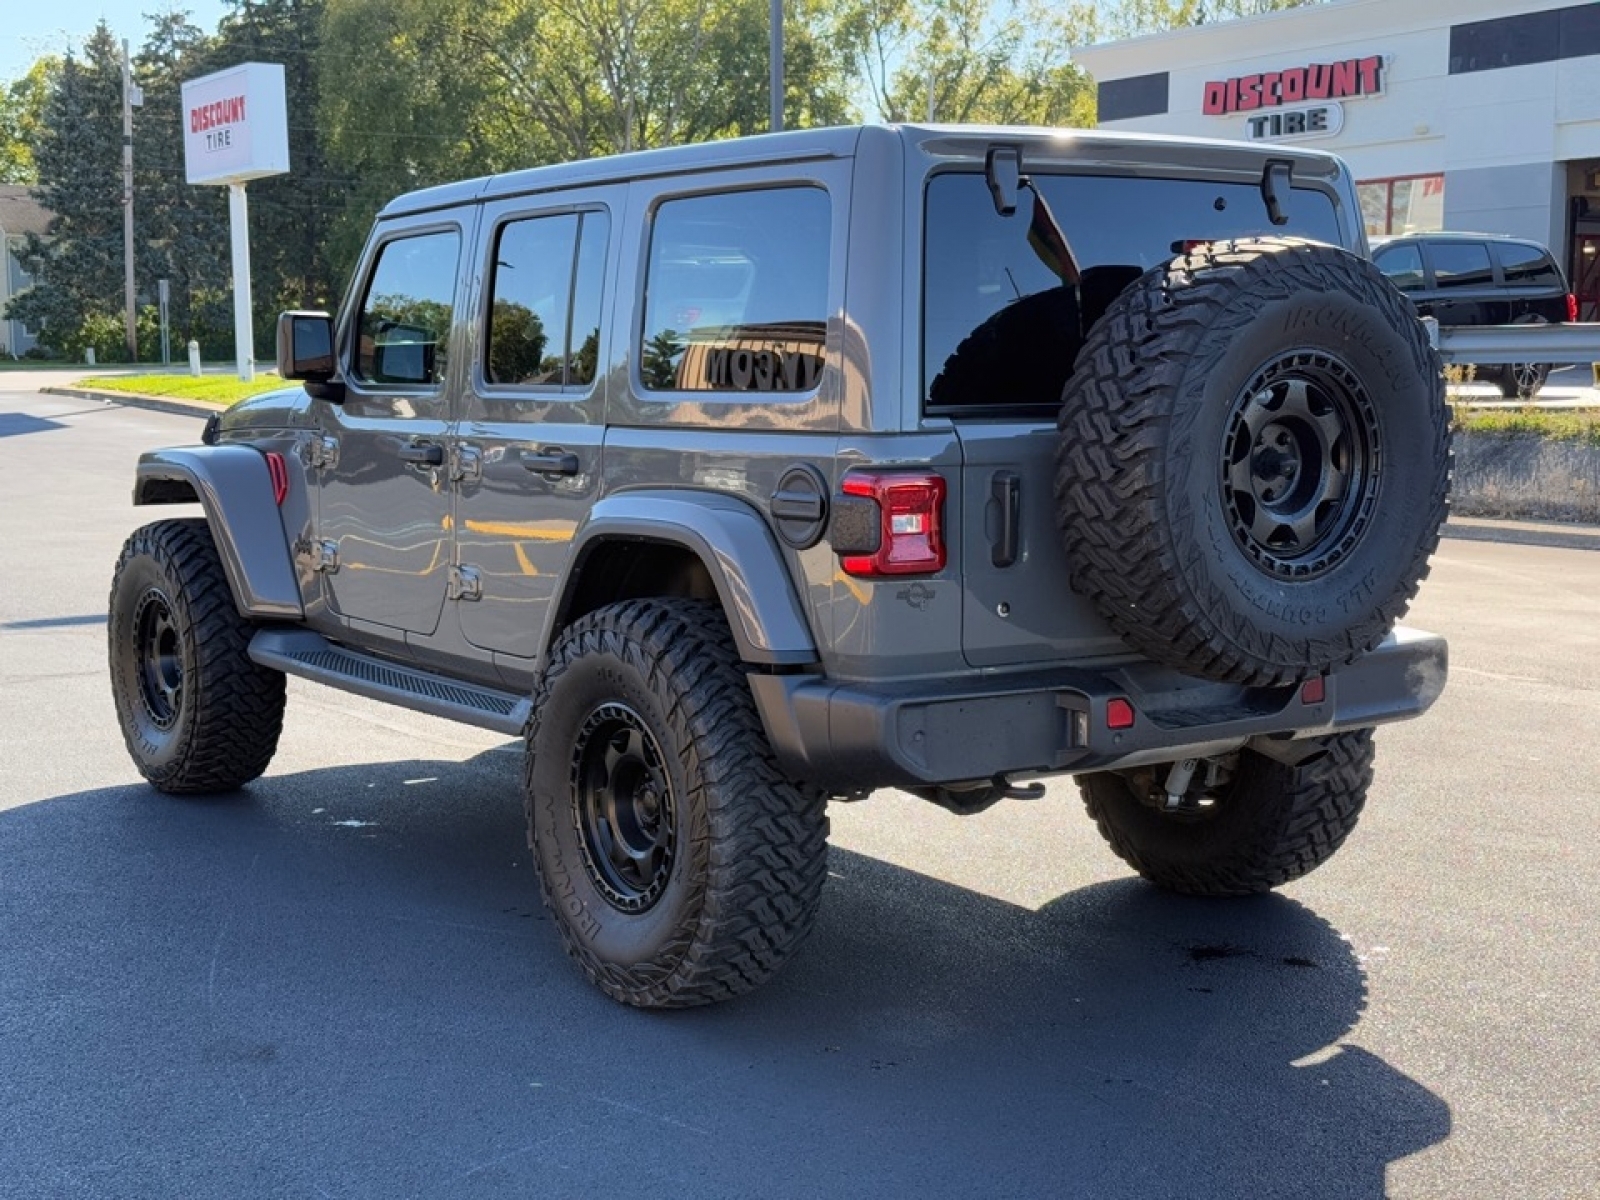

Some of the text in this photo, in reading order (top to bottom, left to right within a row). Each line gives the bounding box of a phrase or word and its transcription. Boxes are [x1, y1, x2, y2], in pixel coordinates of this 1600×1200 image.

[1203, 55, 1383, 115] DISCOUNT
[191, 95, 246, 134] DISCOUNT
[1248, 107, 1328, 138] TIRE
[206, 129, 231, 150] TIRE
